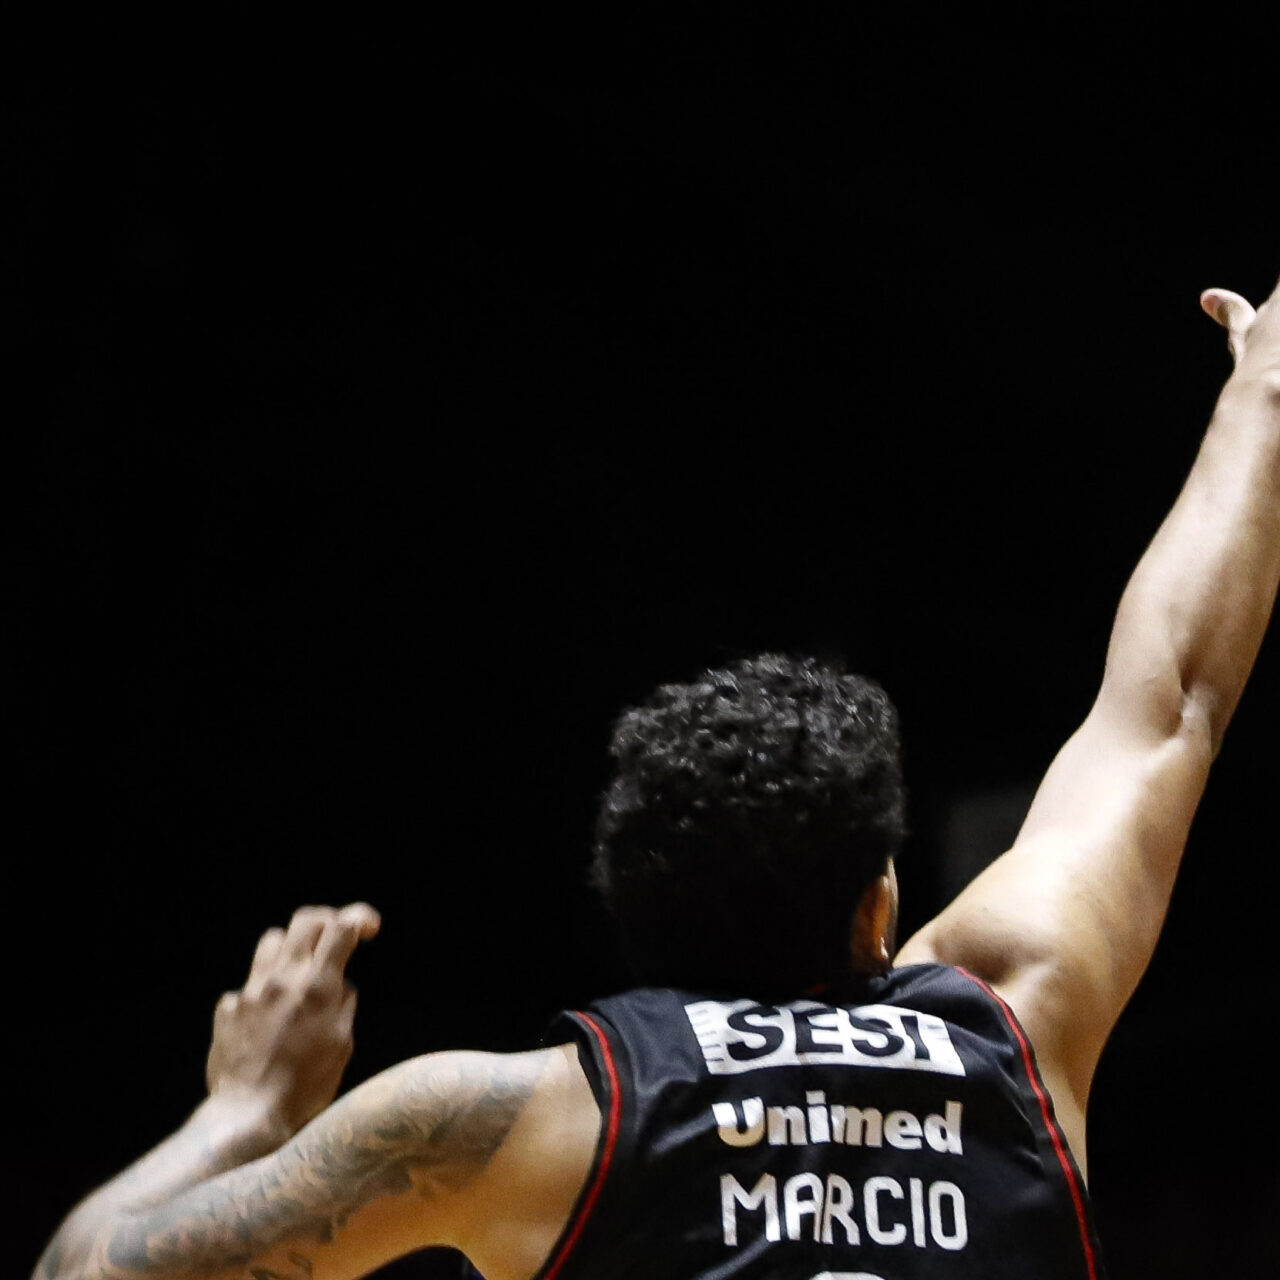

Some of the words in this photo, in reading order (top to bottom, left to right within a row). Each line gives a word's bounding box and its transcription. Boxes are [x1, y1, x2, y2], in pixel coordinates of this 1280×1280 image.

[725, 1004, 931, 1062] SESI
[711, 1090, 964, 1156] Unimed
[720, 1172, 968, 1251] MARCIO
